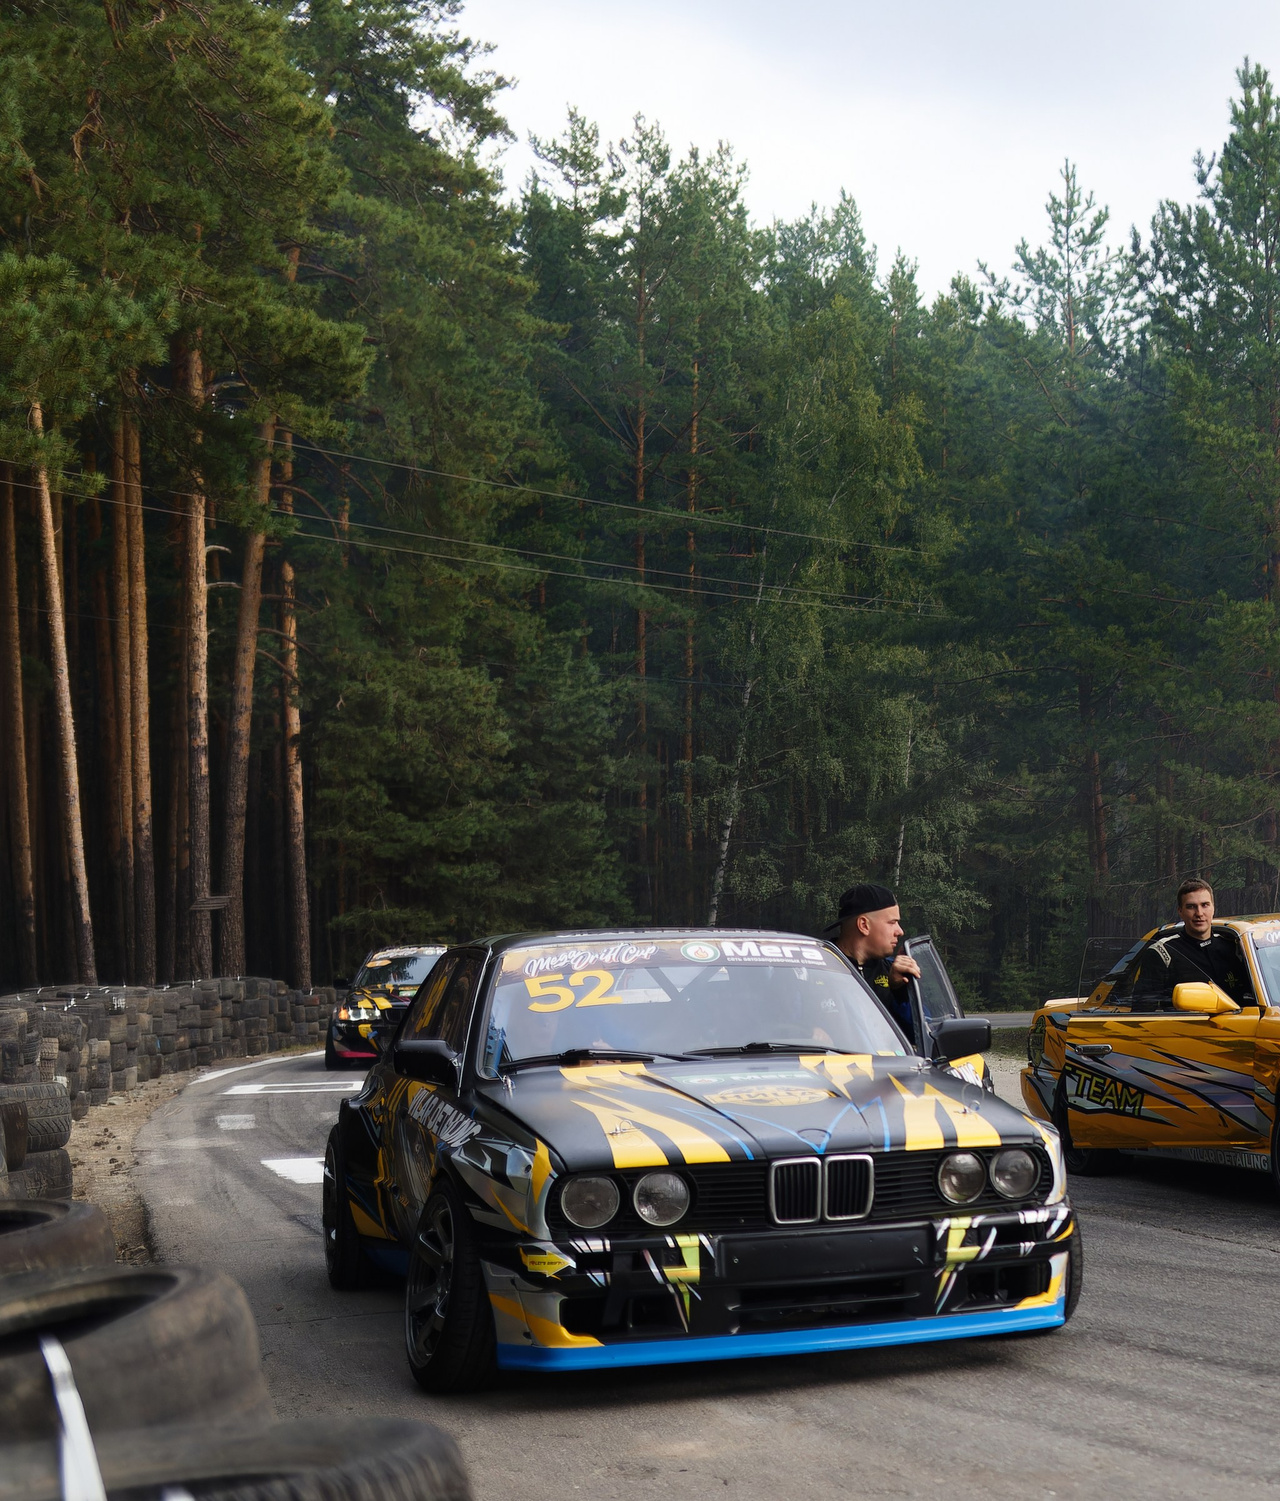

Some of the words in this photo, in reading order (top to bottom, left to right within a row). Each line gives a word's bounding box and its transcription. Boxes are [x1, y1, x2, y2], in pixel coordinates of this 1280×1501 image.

[524, 969, 624, 1013] 52
[1075, 1070, 1142, 1116] TEAM
[1188, 1148, 1216, 1163] VILAR
[1216, 1150, 1268, 1170] DETAILING
